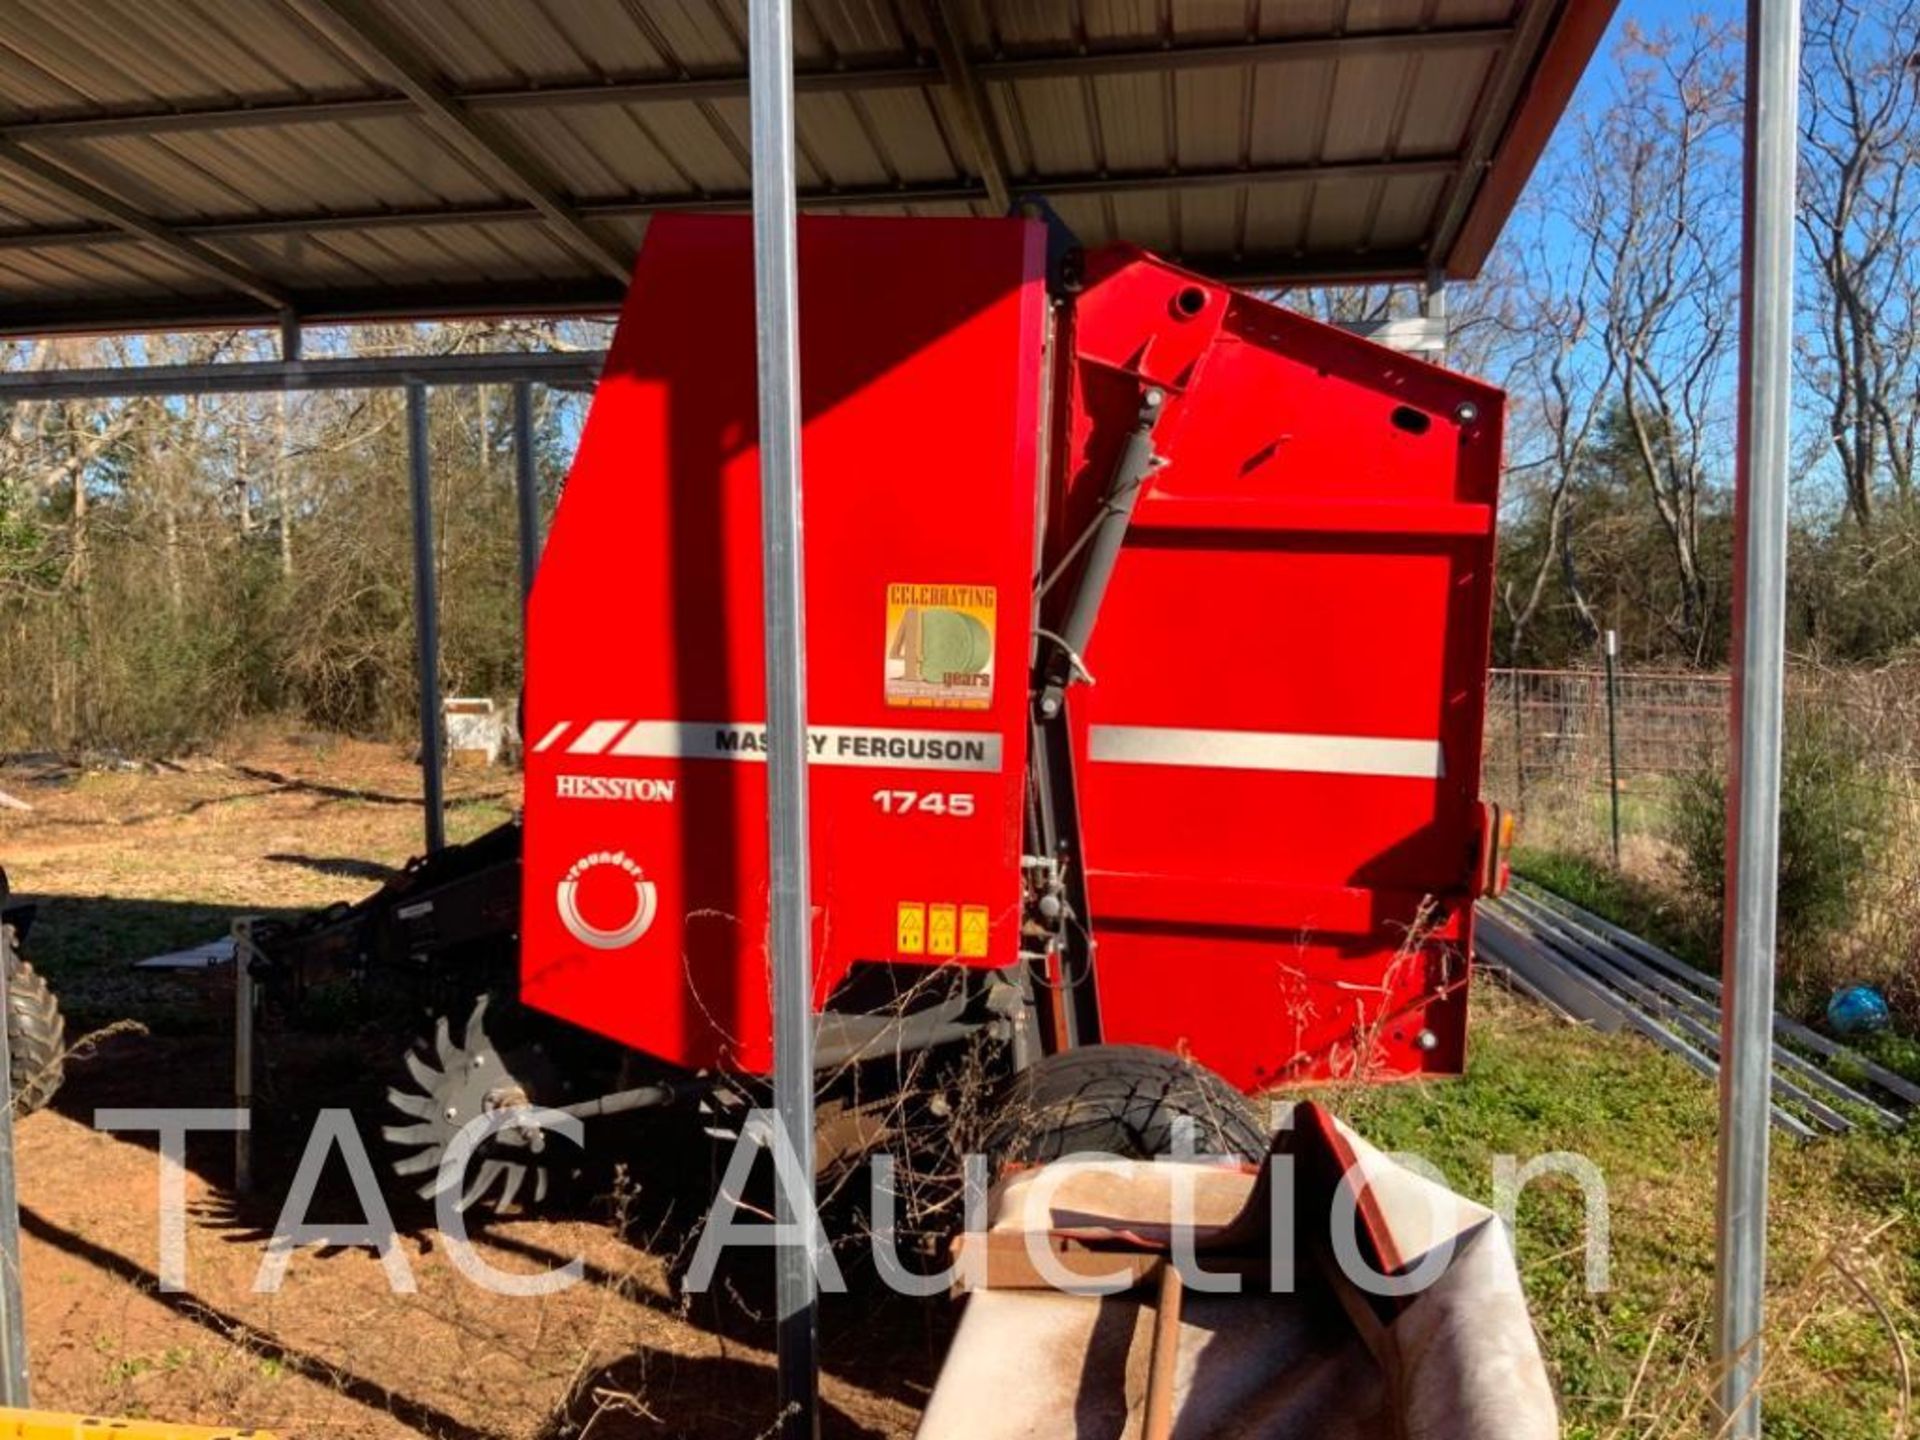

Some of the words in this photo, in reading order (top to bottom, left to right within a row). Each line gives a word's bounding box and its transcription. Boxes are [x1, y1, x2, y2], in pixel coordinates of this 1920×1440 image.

[890, 586, 994, 608] CELEBRATING
[943, 671, 990, 688] years
[715, 728, 827, 755] MASY
[837, 735, 984, 761] FERGUSON
[556, 774, 675, 802] HESSTON
[872, 789, 975, 817] 1745
